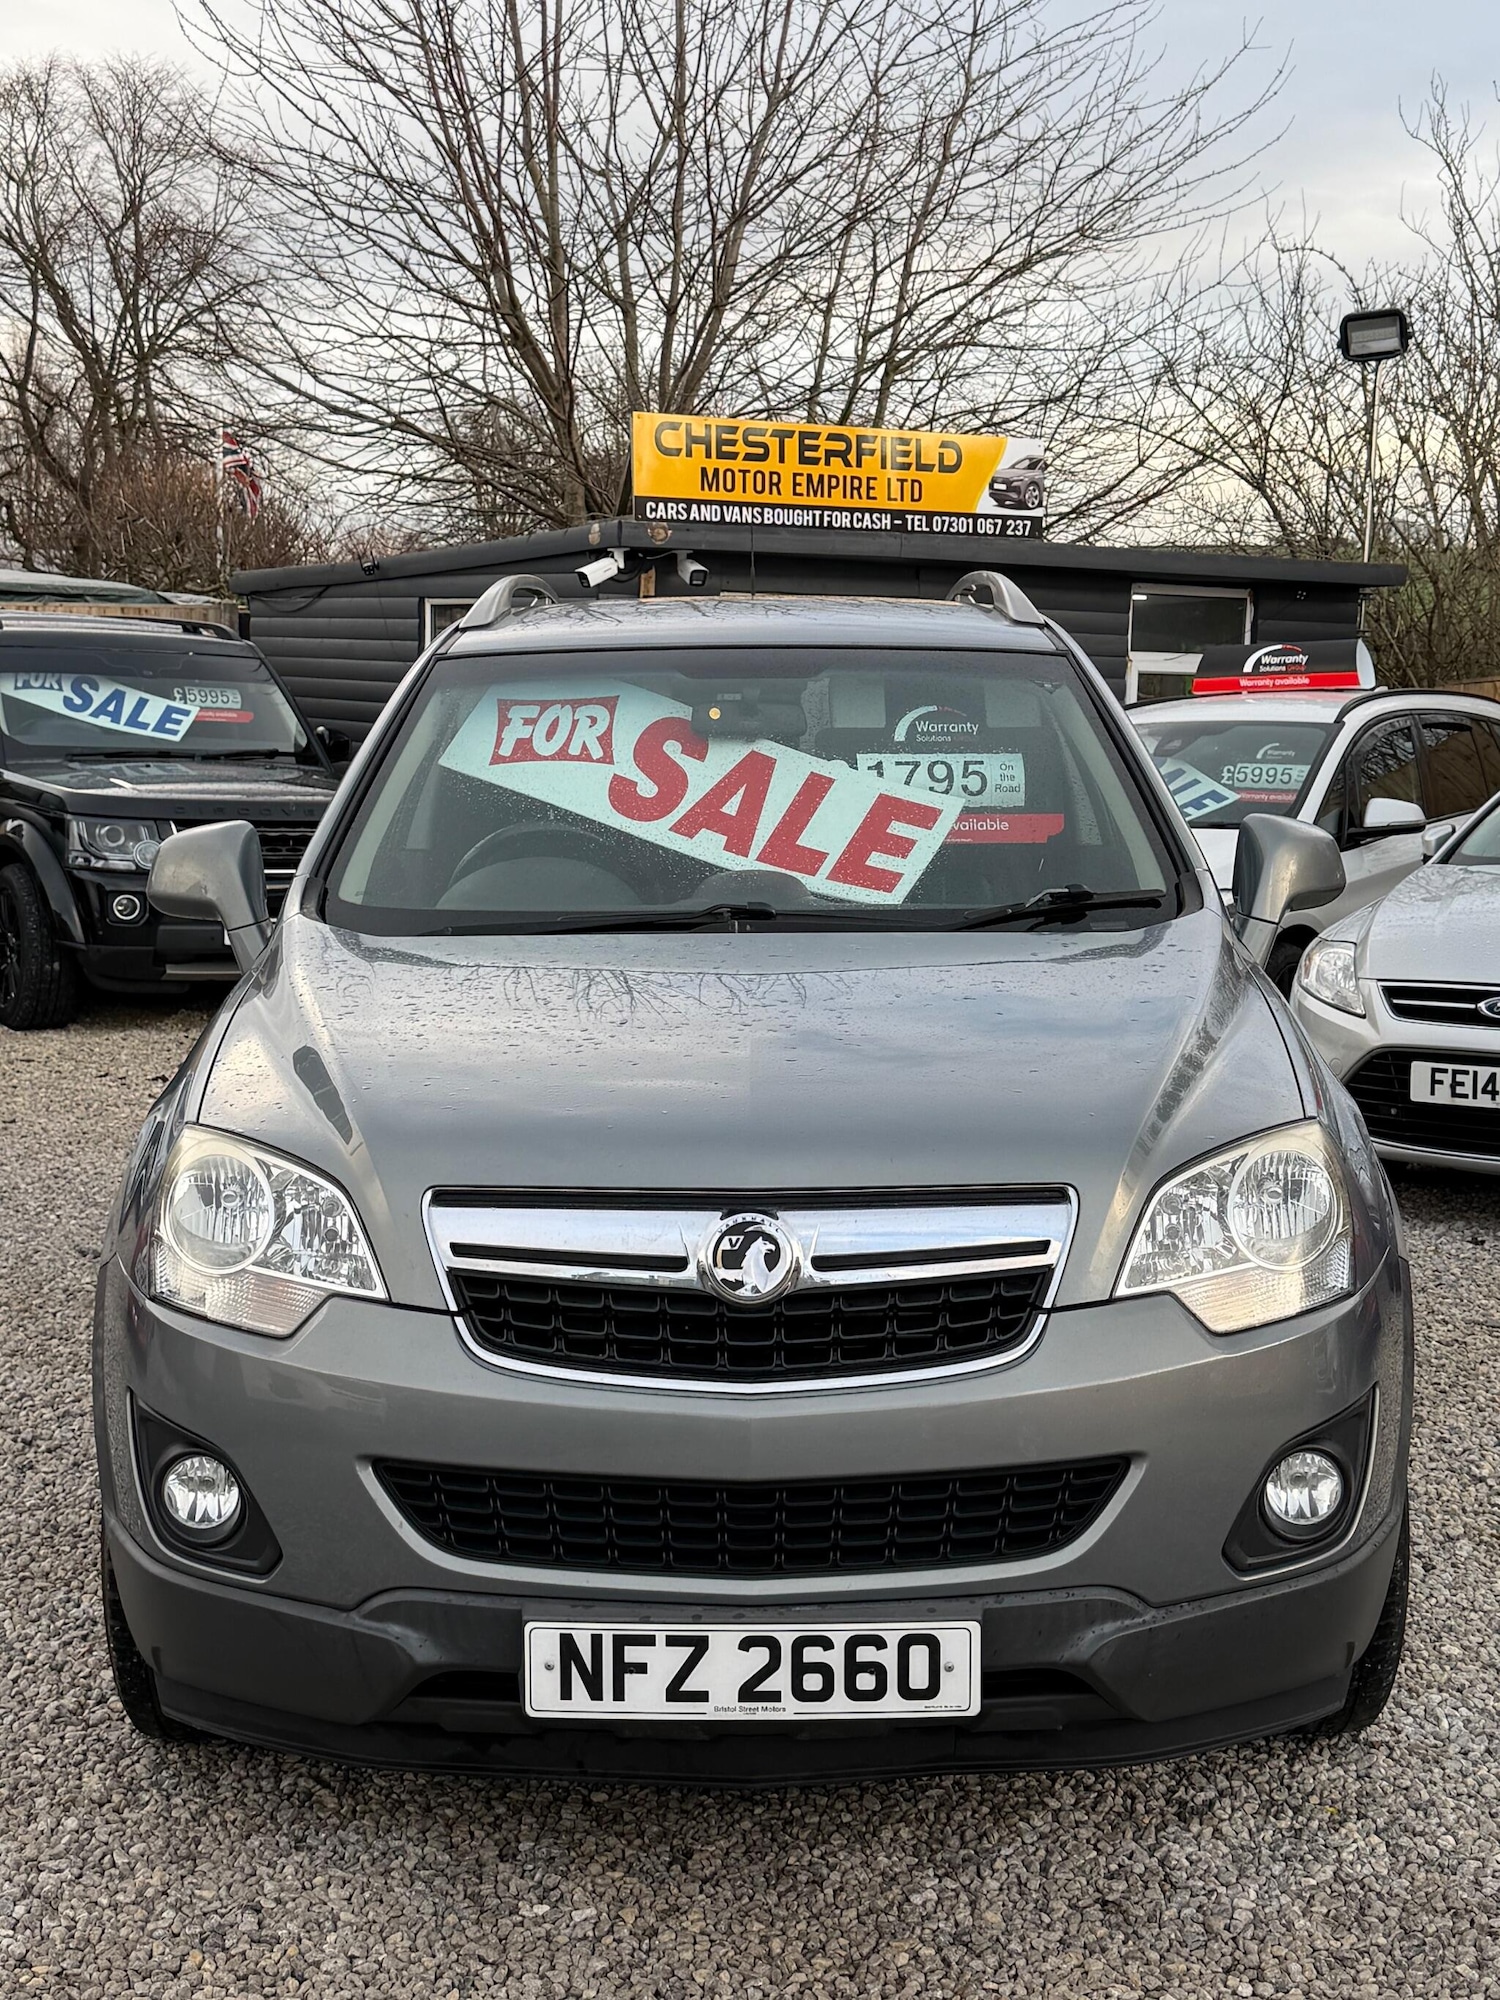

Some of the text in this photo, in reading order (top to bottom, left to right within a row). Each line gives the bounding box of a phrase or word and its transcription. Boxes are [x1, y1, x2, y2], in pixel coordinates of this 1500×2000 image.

[654, 421, 963, 474] CHESTERFIELD
[700, 466, 923, 503] MOTOR EMPIRE LTD
[645, 501, 687, 520] CARS
[689, 503, 721, 522] AND
[723, 505, 762, 524] VANS
[763, 508, 822, 527] BOUGHT
[823, 511, 851, 529] FOR
[852, 512, 892, 531] CASH
[905, 514, 930, 532] TEL
[932, 516, 974, 534] 07301
[976, 517, 1003, 535] 067
[1006, 519, 1032, 536] 237
[1261, 654, 1308, 666] Warranty
[1240, 676, 1310, 688] Warranty available
[62, 675, 191, 736] SALE
[498, 702, 612, 760] FOR
[915, 720, 979, 735] Warranty
[916, 734, 952, 742] Solutions
[999, 763, 1014, 771] On
[1000, 773, 1016, 781] the
[994, 784, 1020, 793] Road
[608, 716, 943, 894] SALE
[953, 818, 1009, 831] vailable
[559, 1633, 942, 1703] NFZ 2660
[713, 1705, 786, 1713] Bristol Street Motors
